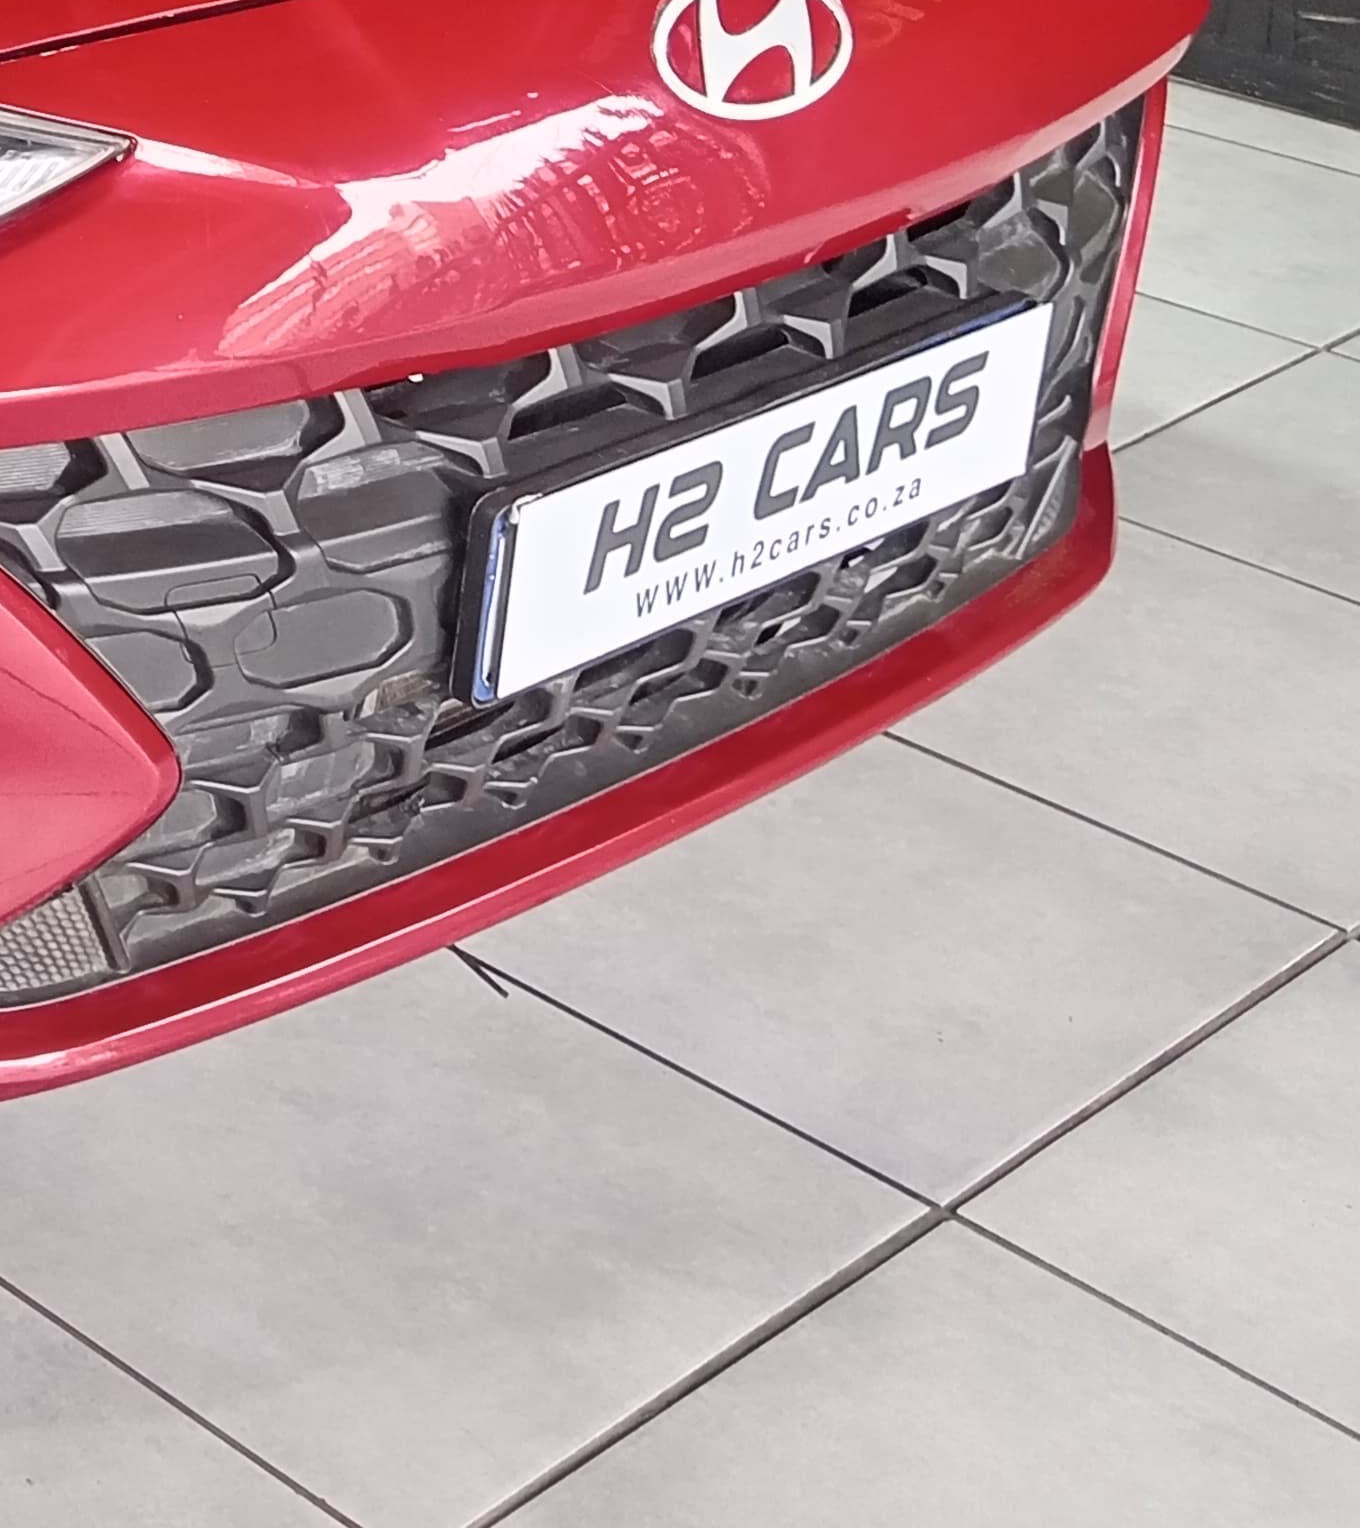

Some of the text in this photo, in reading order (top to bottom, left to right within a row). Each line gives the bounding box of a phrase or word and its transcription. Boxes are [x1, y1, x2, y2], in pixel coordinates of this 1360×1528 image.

[584, 351, 990, 594] H2 CARS
[635, 478, 921, 618] www.h2cars.co.za
